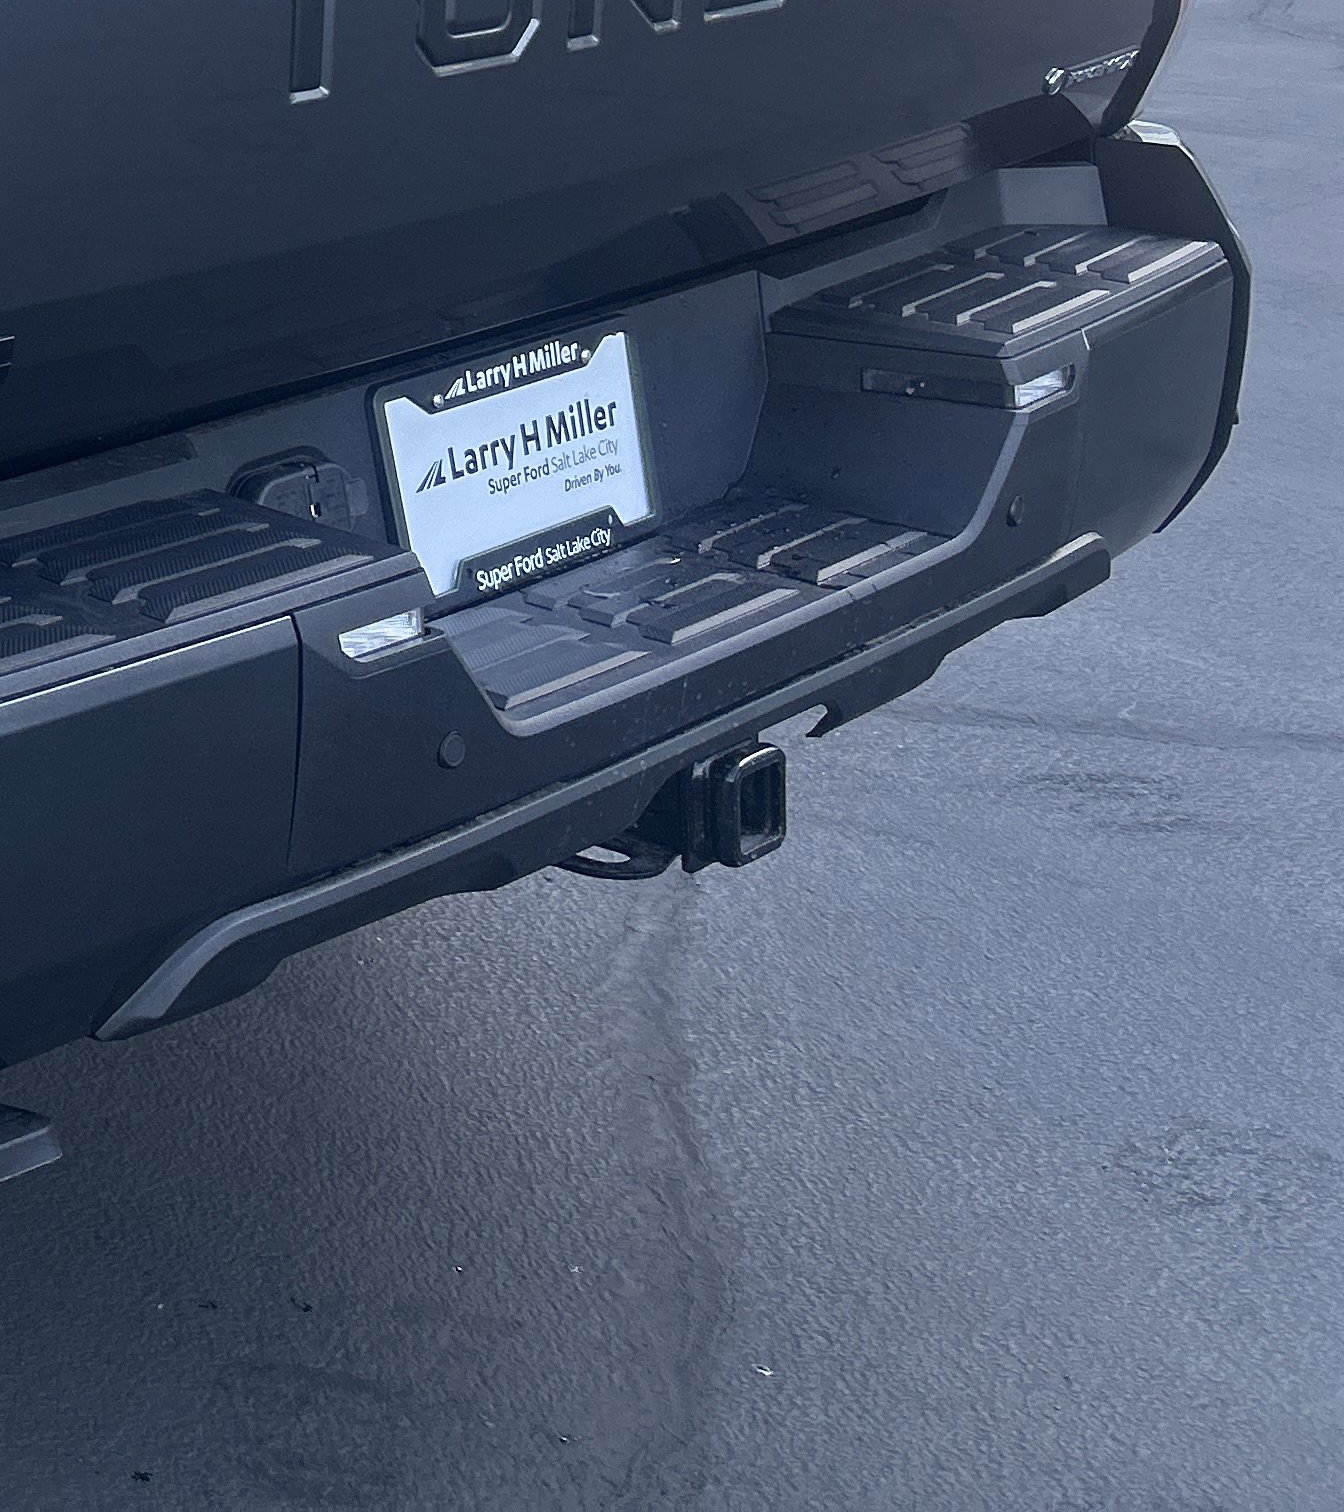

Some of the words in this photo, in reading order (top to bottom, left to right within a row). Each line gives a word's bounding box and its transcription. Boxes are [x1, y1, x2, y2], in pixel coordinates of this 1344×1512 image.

[465, 361, 511, 393] Larry
[512, 354, 528, 379] H
[528, 340, 579, 374] Miller
[447, 434, 516, 481] Larry
[519, 419, 542, 456] H
[545, 398, 617, 448] Miller
[488, 472, 522, 494] Super
[523, 458, 550, 483] Ford
[551, 452, 572, 473] Salt
[572, 444, 597, 465] Lake
[598, 438, 619, 456] City
[564, 474, 592, 492] Driven
[594, 468, 605, 483] By
[476, 562, 514, 591] Super
[513, 547, 544, 576] Ford
[545, 543, 567, 565] Salt
[566, 536, 592, 556] Lake
[591, 528, 611, 547] City
